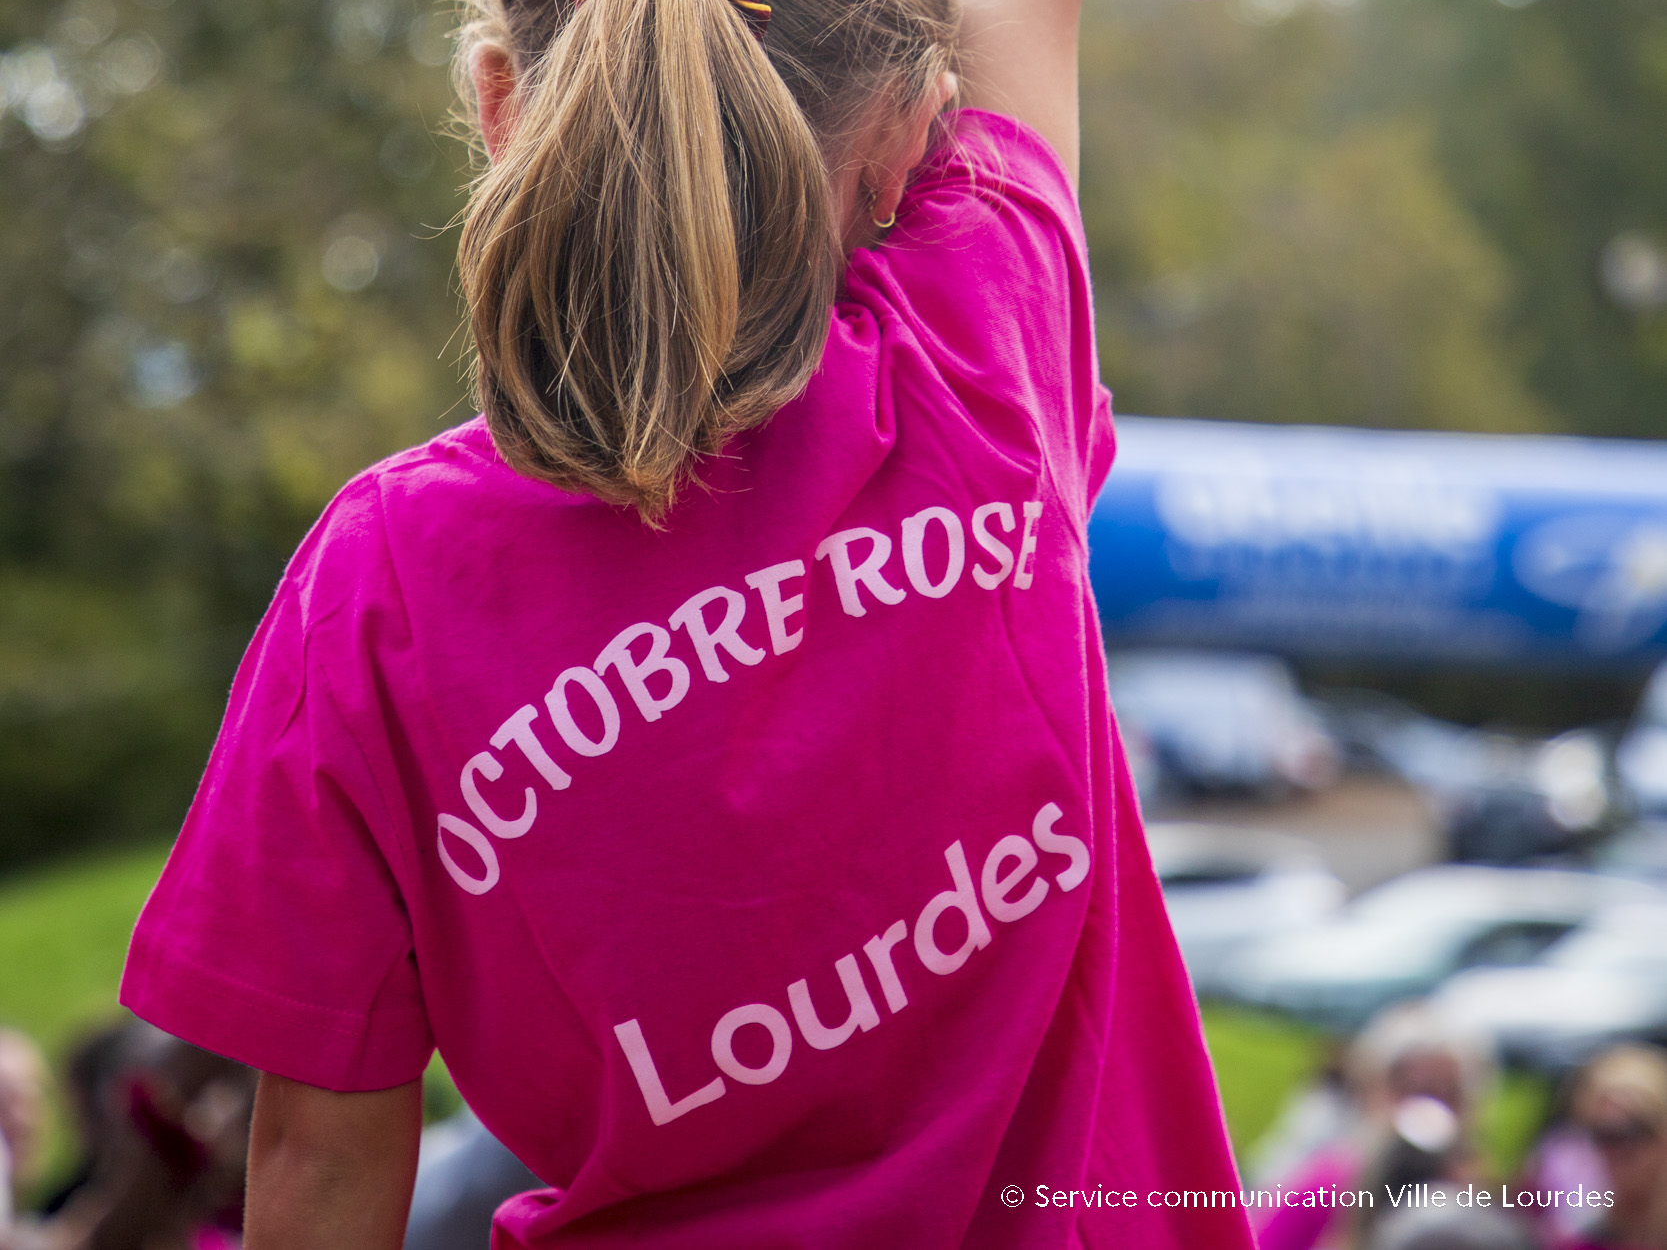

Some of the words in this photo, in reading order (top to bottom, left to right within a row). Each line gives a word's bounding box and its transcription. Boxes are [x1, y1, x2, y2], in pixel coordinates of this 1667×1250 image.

[437, 559, 805, 895] OCTOBRE
[815, 502, 1043, 617] ROSE
[614, 802, 1091, 1126] Lourdes
